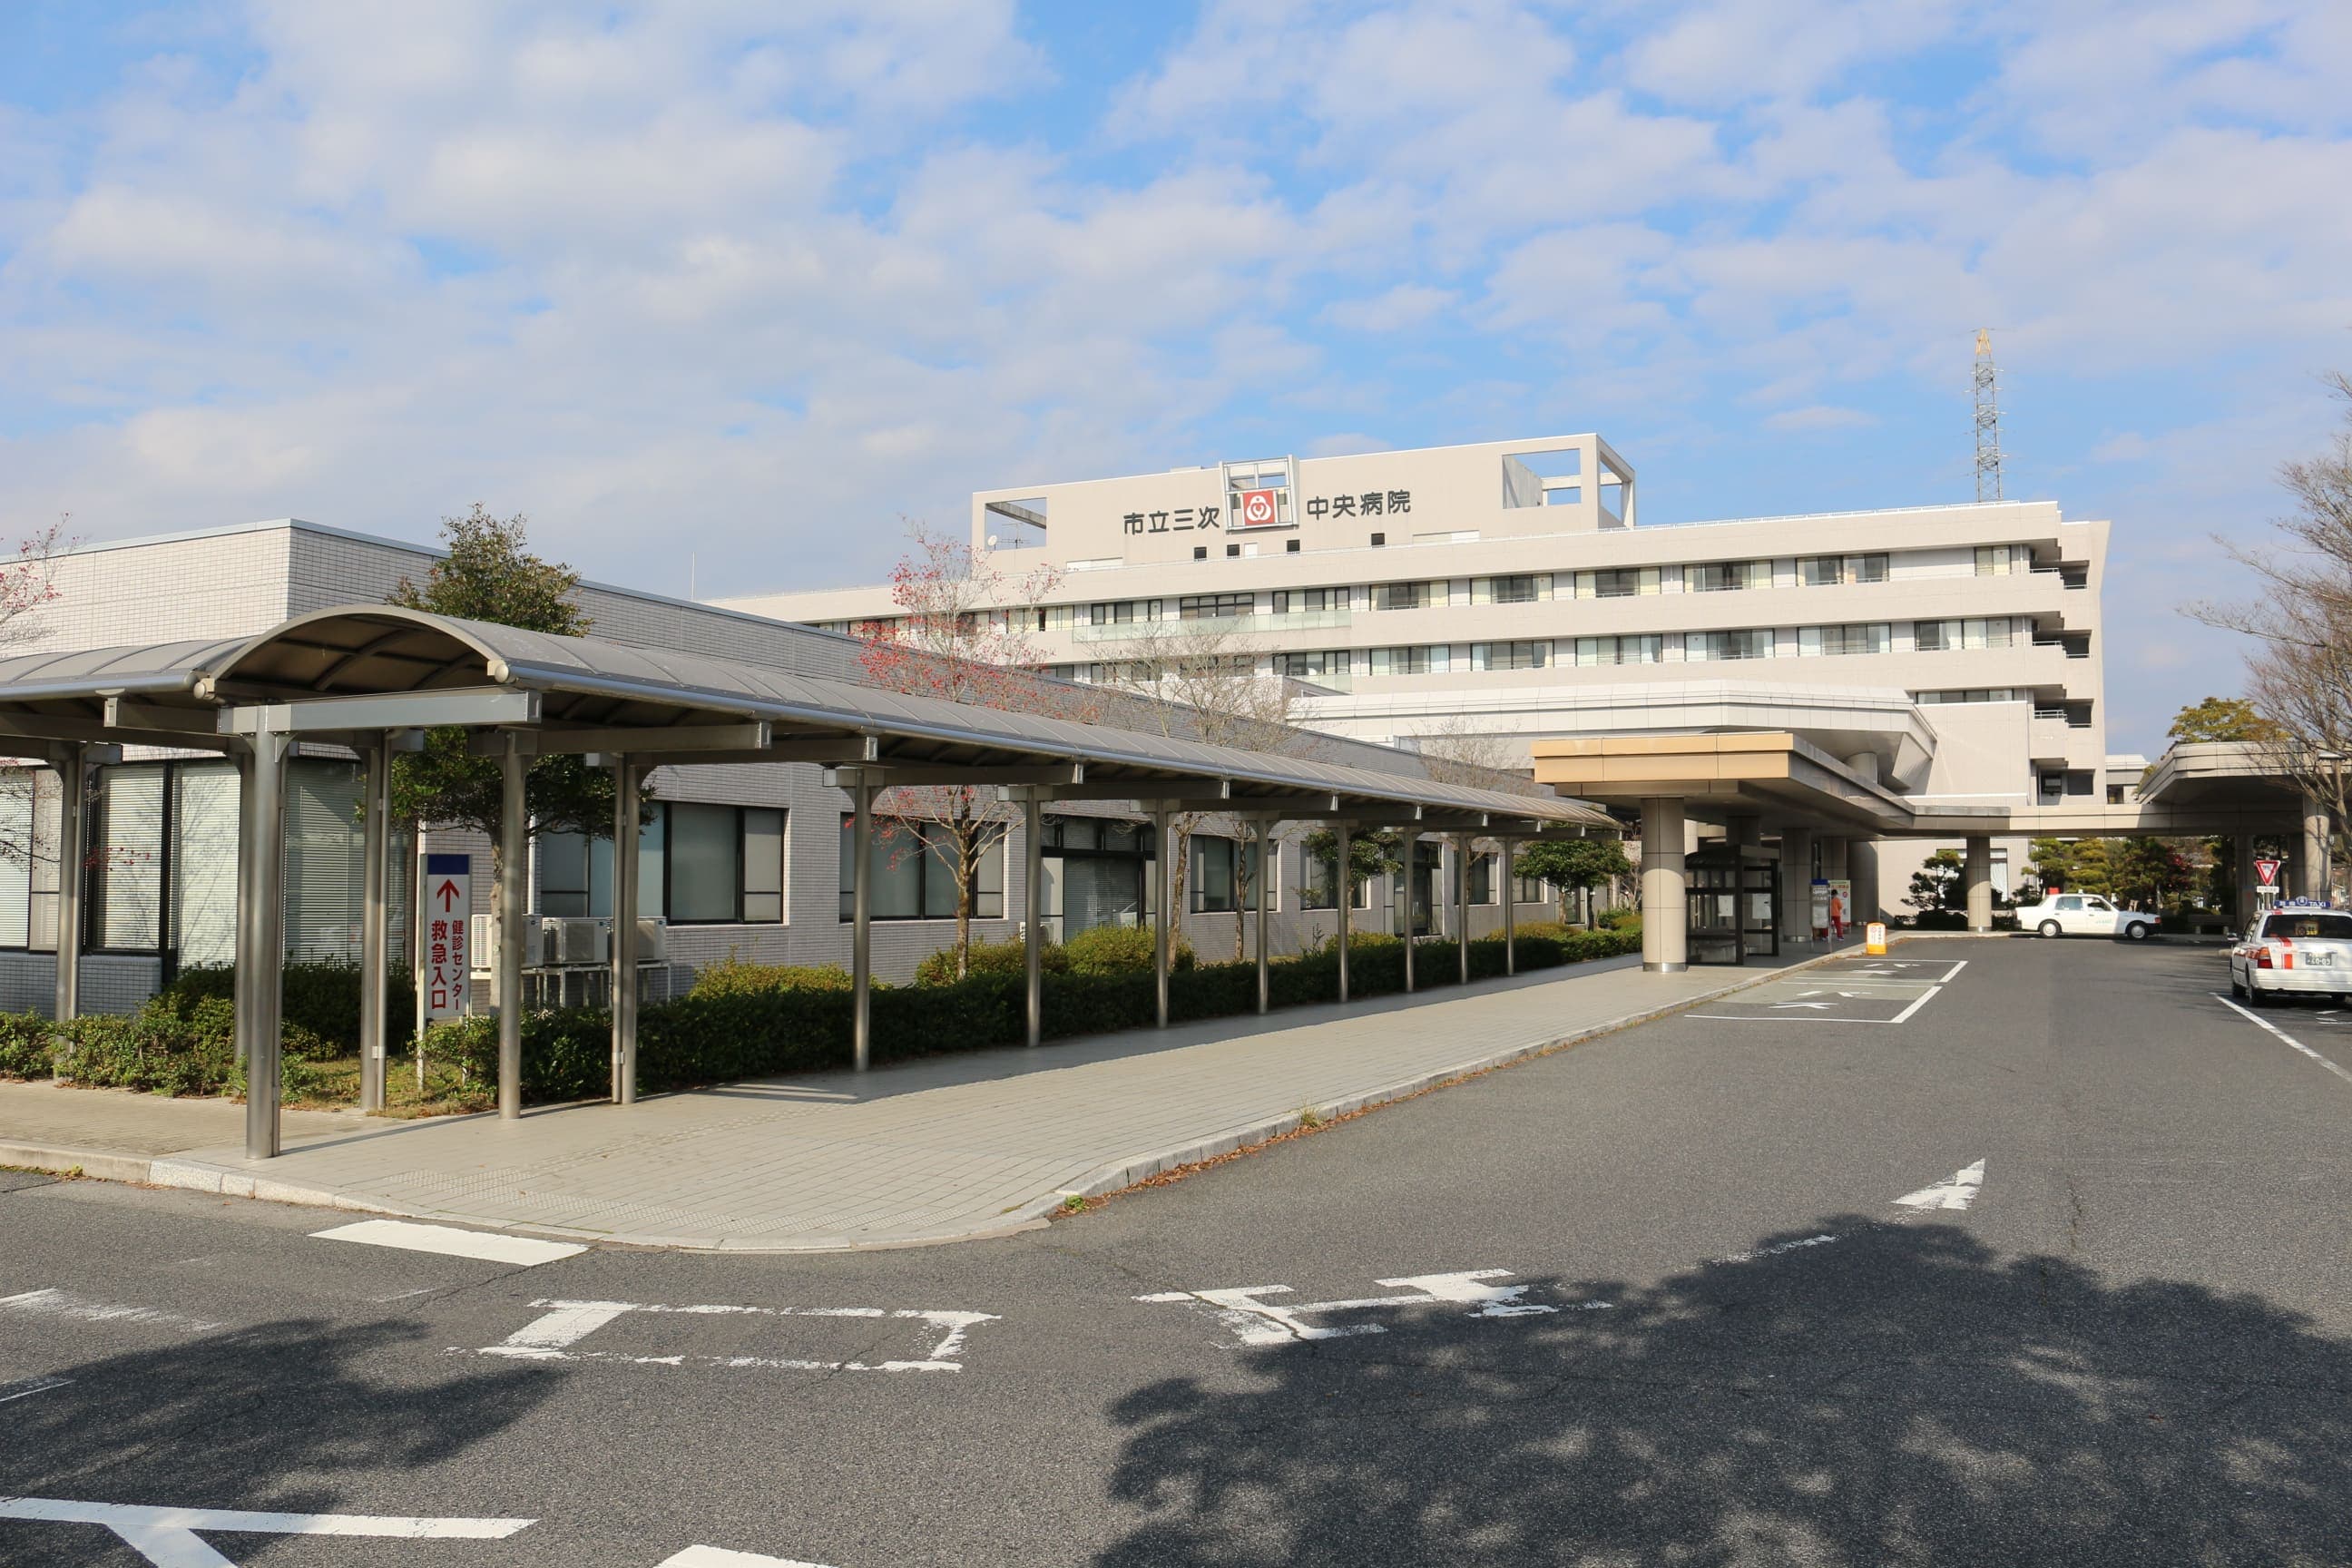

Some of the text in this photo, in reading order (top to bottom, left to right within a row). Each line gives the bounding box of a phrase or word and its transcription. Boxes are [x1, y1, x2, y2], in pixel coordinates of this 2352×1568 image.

[1123, 488, 1411, 535] 市立三次 中央病院
[430, 919, 448, 1010] 救急入口
[452, 919, 465, 1011] 健診センター
